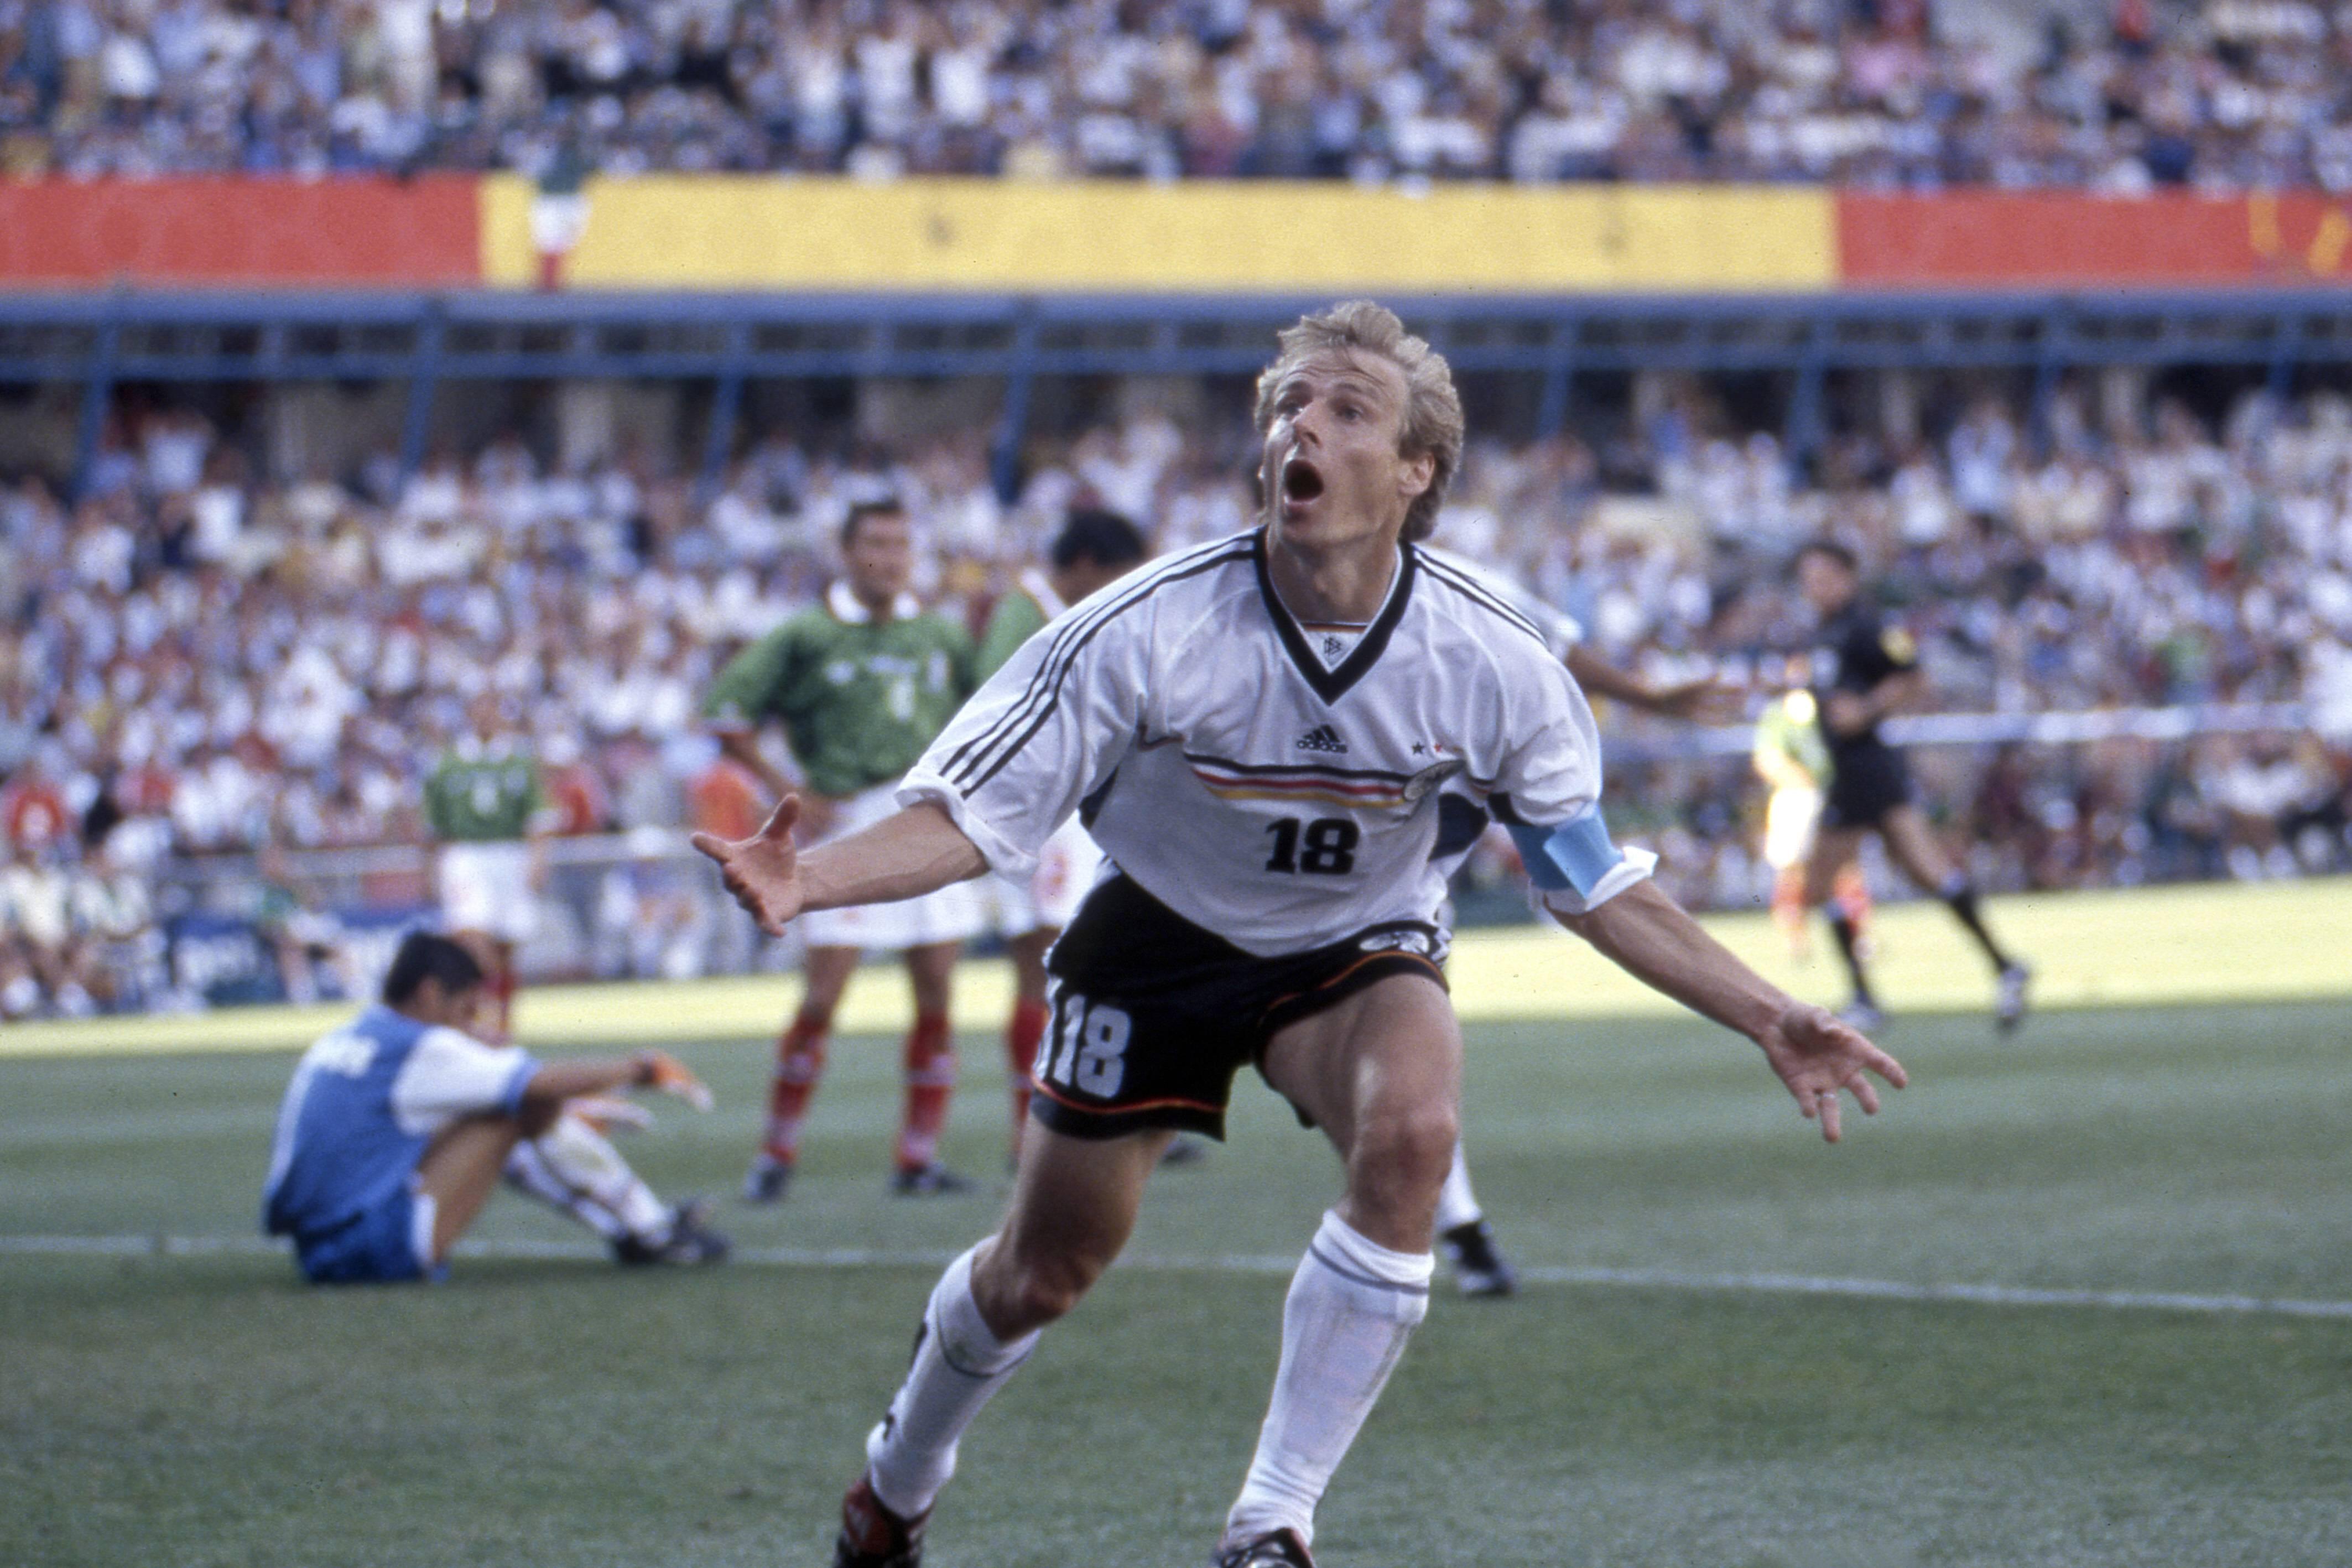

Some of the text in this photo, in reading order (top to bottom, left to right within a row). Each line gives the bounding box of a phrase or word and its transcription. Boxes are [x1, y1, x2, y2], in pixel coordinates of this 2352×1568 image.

[1296, 738, 1349, 753] adidas
[1265, 817, 1360, 875] 18
[1053, 994, 1132, 1100] 18
